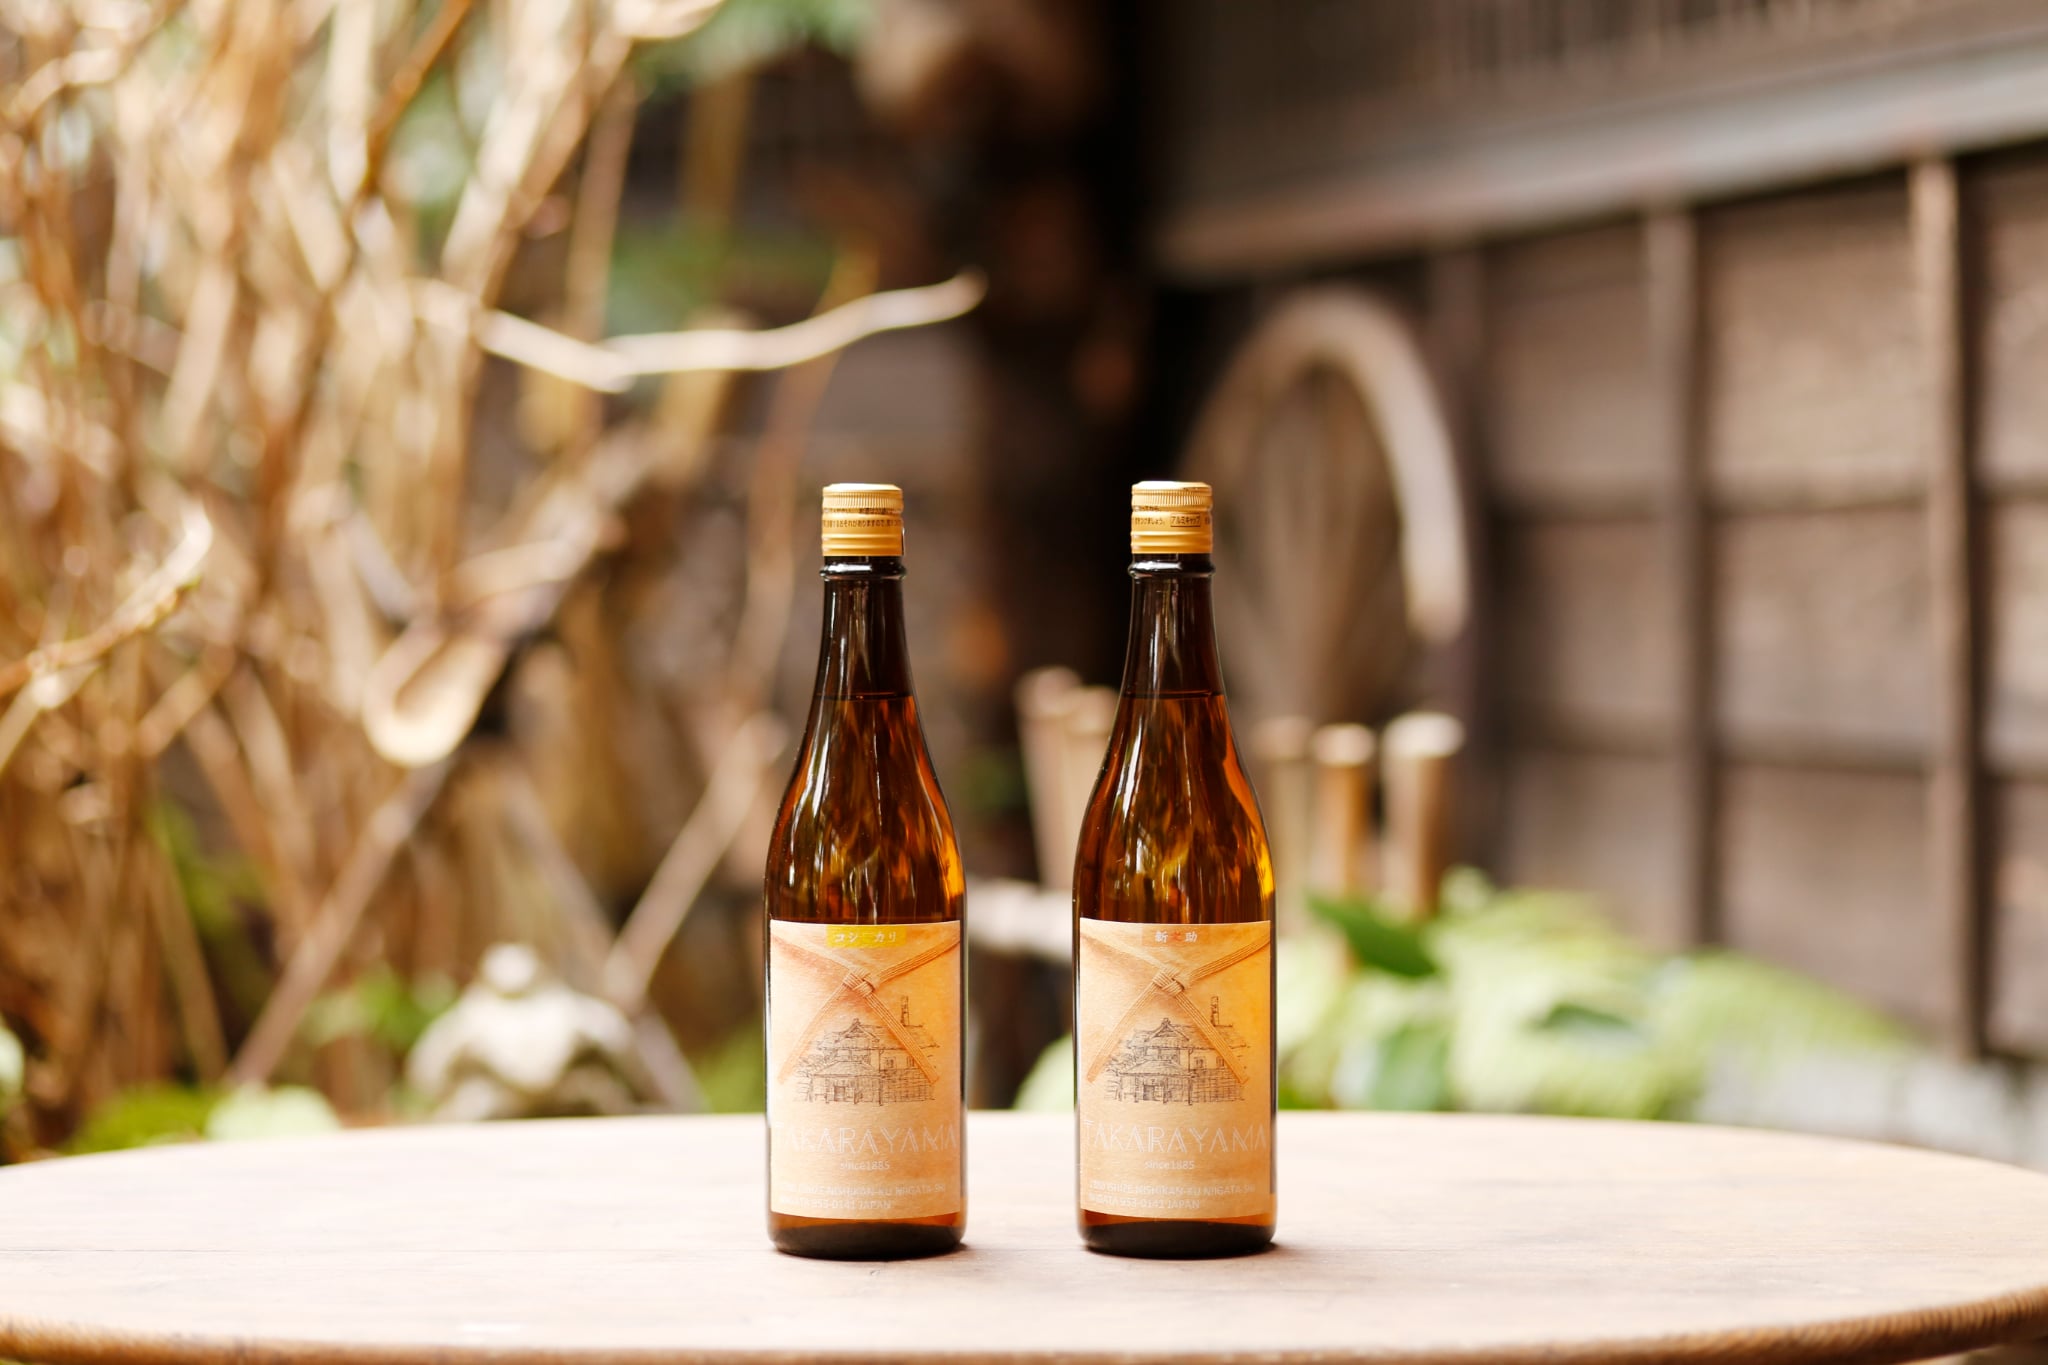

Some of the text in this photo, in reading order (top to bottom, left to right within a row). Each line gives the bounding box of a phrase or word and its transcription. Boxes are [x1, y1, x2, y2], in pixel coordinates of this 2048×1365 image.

[834, 931, 897, 943] コシカリ
[774, 1120, 957, 1154] AKARAYAMA
[1168, 1199, 1200, 1209] JAPAN
